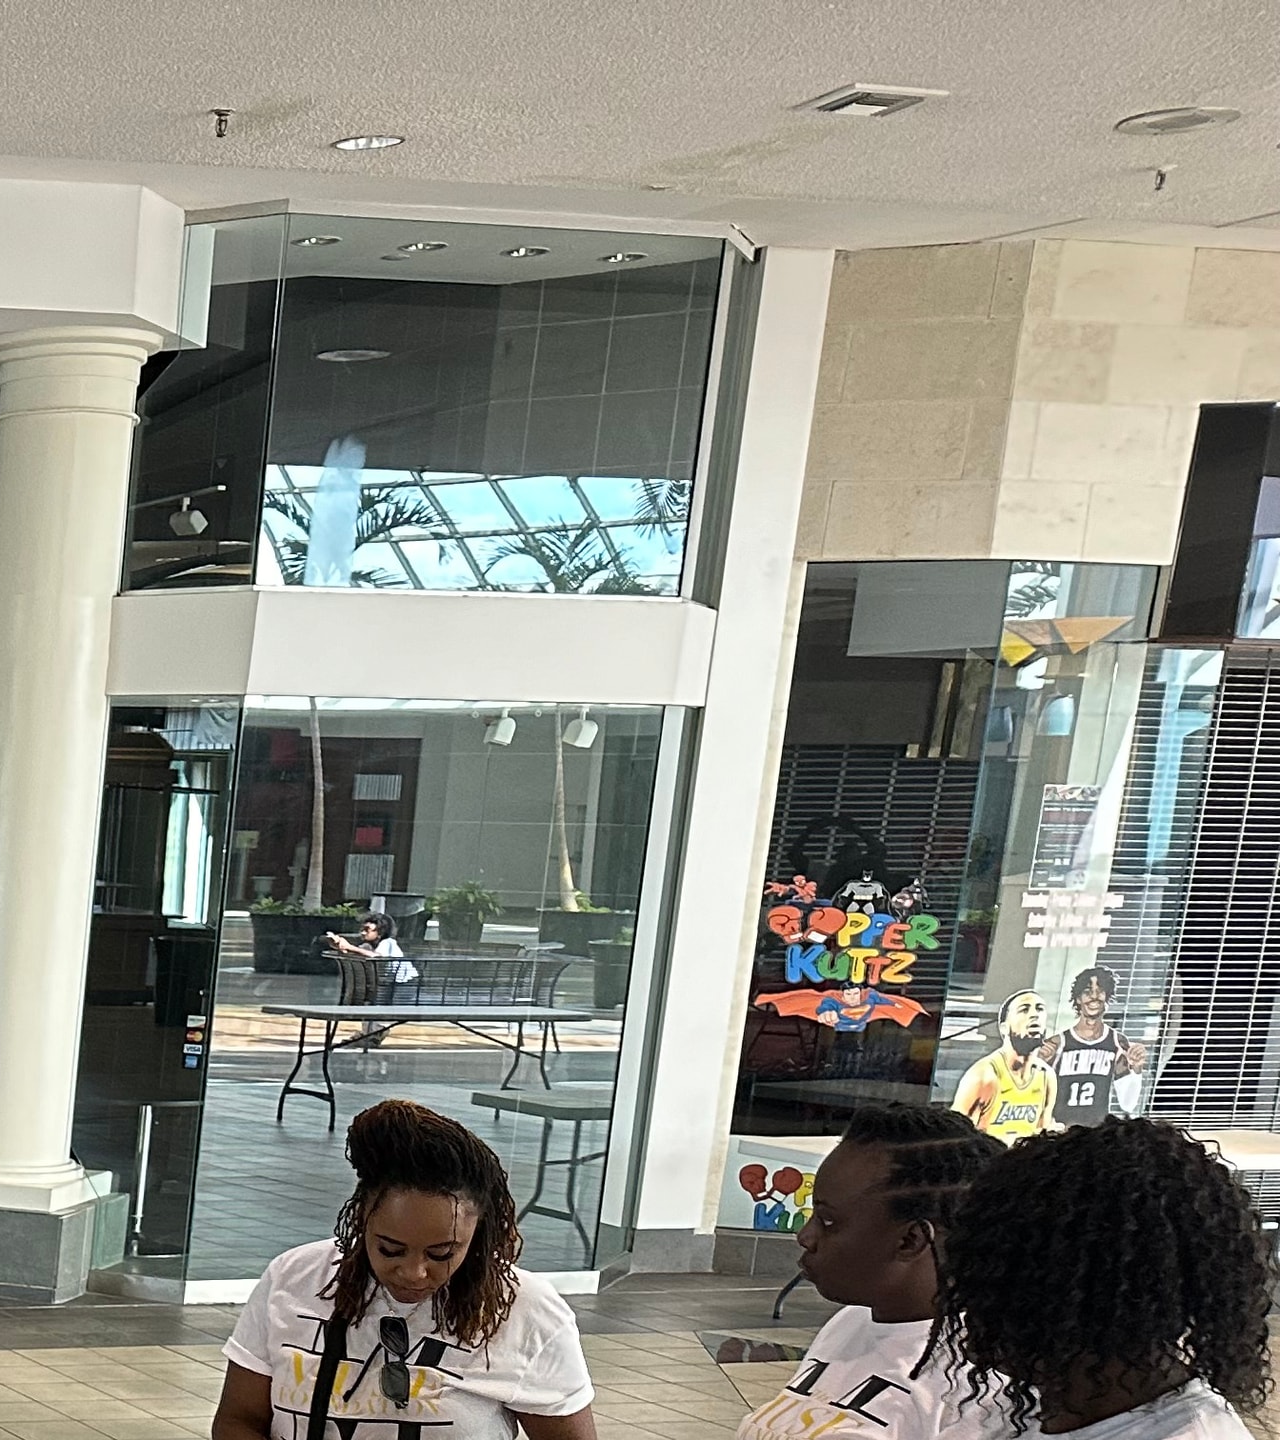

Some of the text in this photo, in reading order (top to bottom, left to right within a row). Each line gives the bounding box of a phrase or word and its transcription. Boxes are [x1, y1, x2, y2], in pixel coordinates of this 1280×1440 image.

[1059, 1048, 1116, 1077] MEMPHIS
[1067, 1081, 1096, 1107] 12
[991, 1101, 1039, 1125] LAKERS
